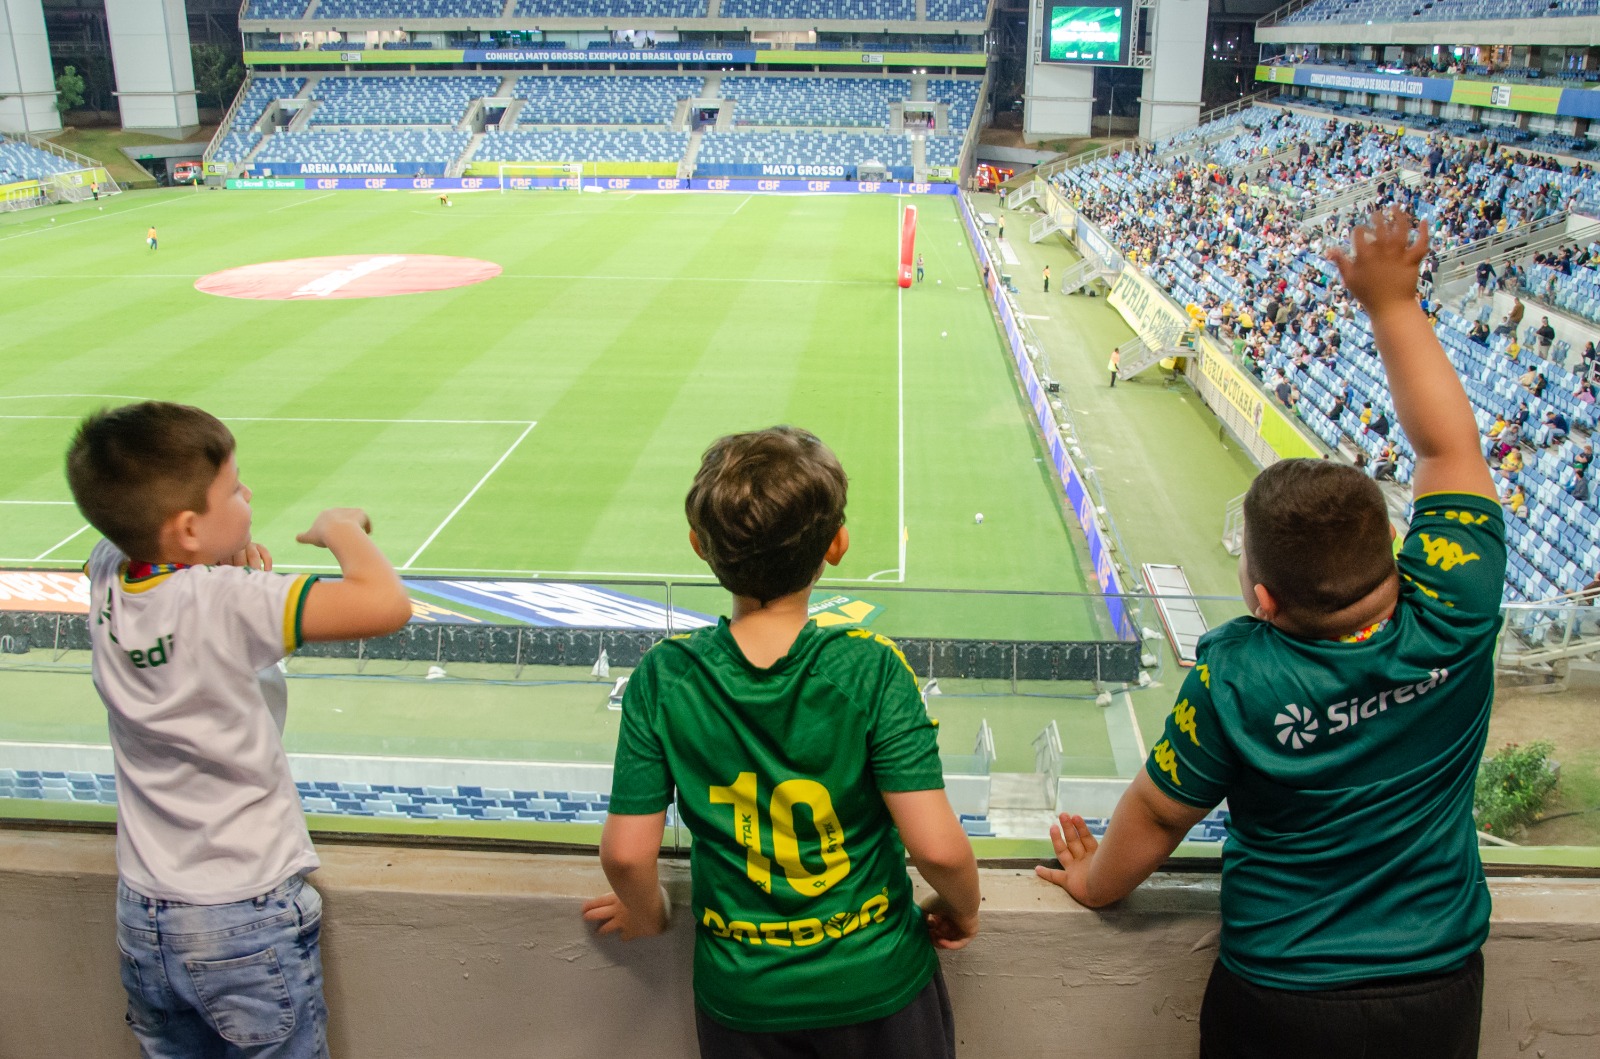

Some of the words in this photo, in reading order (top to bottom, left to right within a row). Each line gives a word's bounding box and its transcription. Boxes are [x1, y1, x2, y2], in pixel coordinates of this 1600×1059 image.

[486, 52, 524, 62] CONHEÇA
[526, 52, 549, 60] MATO
[551, 52, 588, 60] GROSSO:
[589, 52, 628, 60] EXEMPLO
[630, 52, 641, 60] DE
[642, 52, 672, 61] BRASIL
[674, 53, 691, 61] QUE
[692, 50, 704, 61] DÁ
[706, 53, 733, 61] CERTO
[1376, 79, 1390, 92] BRASIL
[1390, 81, 1400, 92] QUE
[1407, 81, 1423, 95] CERTO
[300, 164, 336, 173] ARENA
[339, 163, 397, 174] PANTANAL
[762, 165, 795, 175] MATO
[798, 165, 844, 176] GROSSO
[317, 179, 339, 189] CBF
[365, 179, 386, 189] CBF
[413, 179, 434, 188] CBF
[461, 178, 483, 188] CBF
[608, 179, 630, 189] CBF
[658, 179, 680, 189] CBF
[708, 180, 730, 189] CBF
[758, 180, 779, 190] CBF
[808, 181, 830, 191] CBF
[858, 182, 880, 192] CBF
[908, 183, 931, 194] CBF
[1114, 272, 1149, 318] FURIA
[1327, 668, 1449, 735] Sicredi
[709, 772, 850, 897] 10
